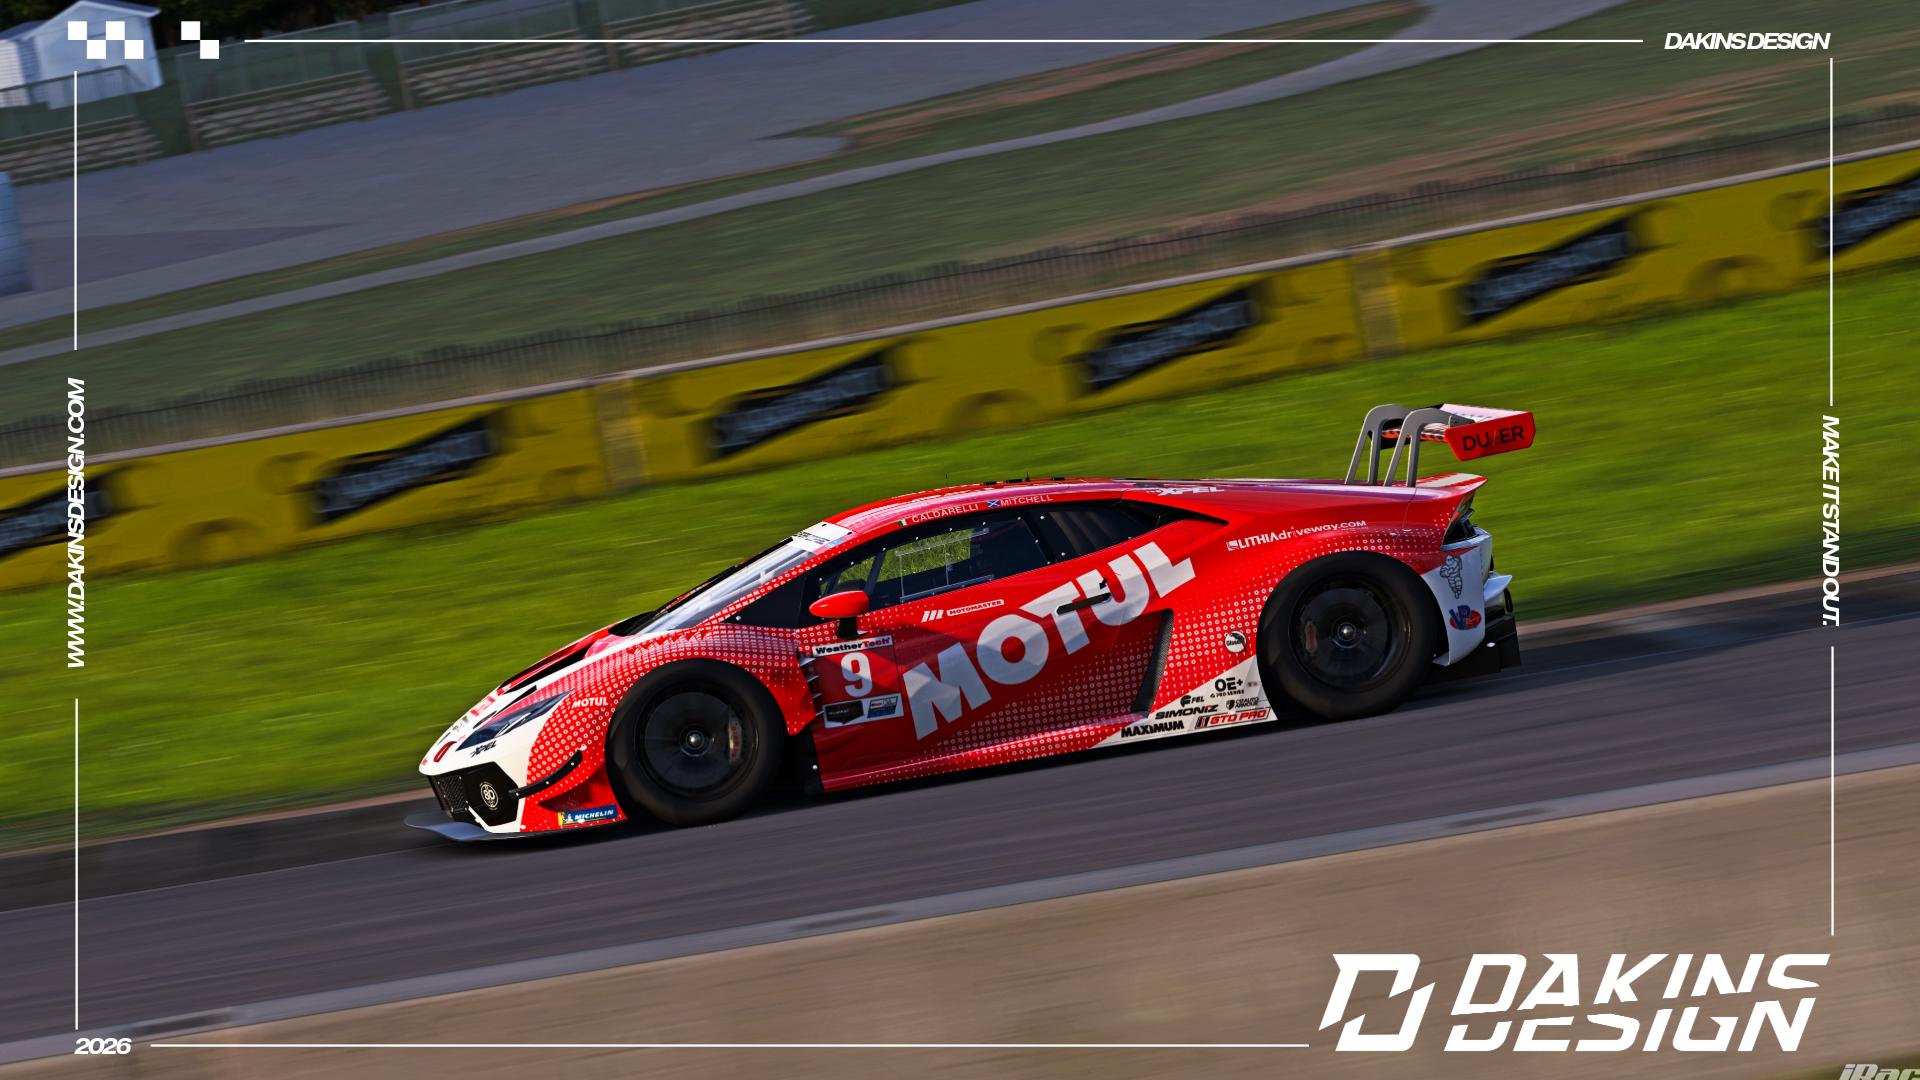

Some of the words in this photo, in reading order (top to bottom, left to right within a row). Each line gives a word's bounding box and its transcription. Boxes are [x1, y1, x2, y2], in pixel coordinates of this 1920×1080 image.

[1000, 495, 1054, 507] MITCHELL
[911, 504, 979, 524] CALDARELLI
[950, 600, 1003, 616] MOTOMASTER
[815, 636, 891, 655] WeatherTech
[902, 540, 1196, 741] MOTUL
[840, 651, 873, 698] 9
[572, 696, 609, 709] MOTUL
[1154, 704, 1219, 720] SIMONIZ
[1239, 709, 1267, 720] PRO
[1120, 720, 1185, 738] MAXIMUM
[483, 789, 496, 801] 80
[574, 809, 614, 821] MICHELIN
